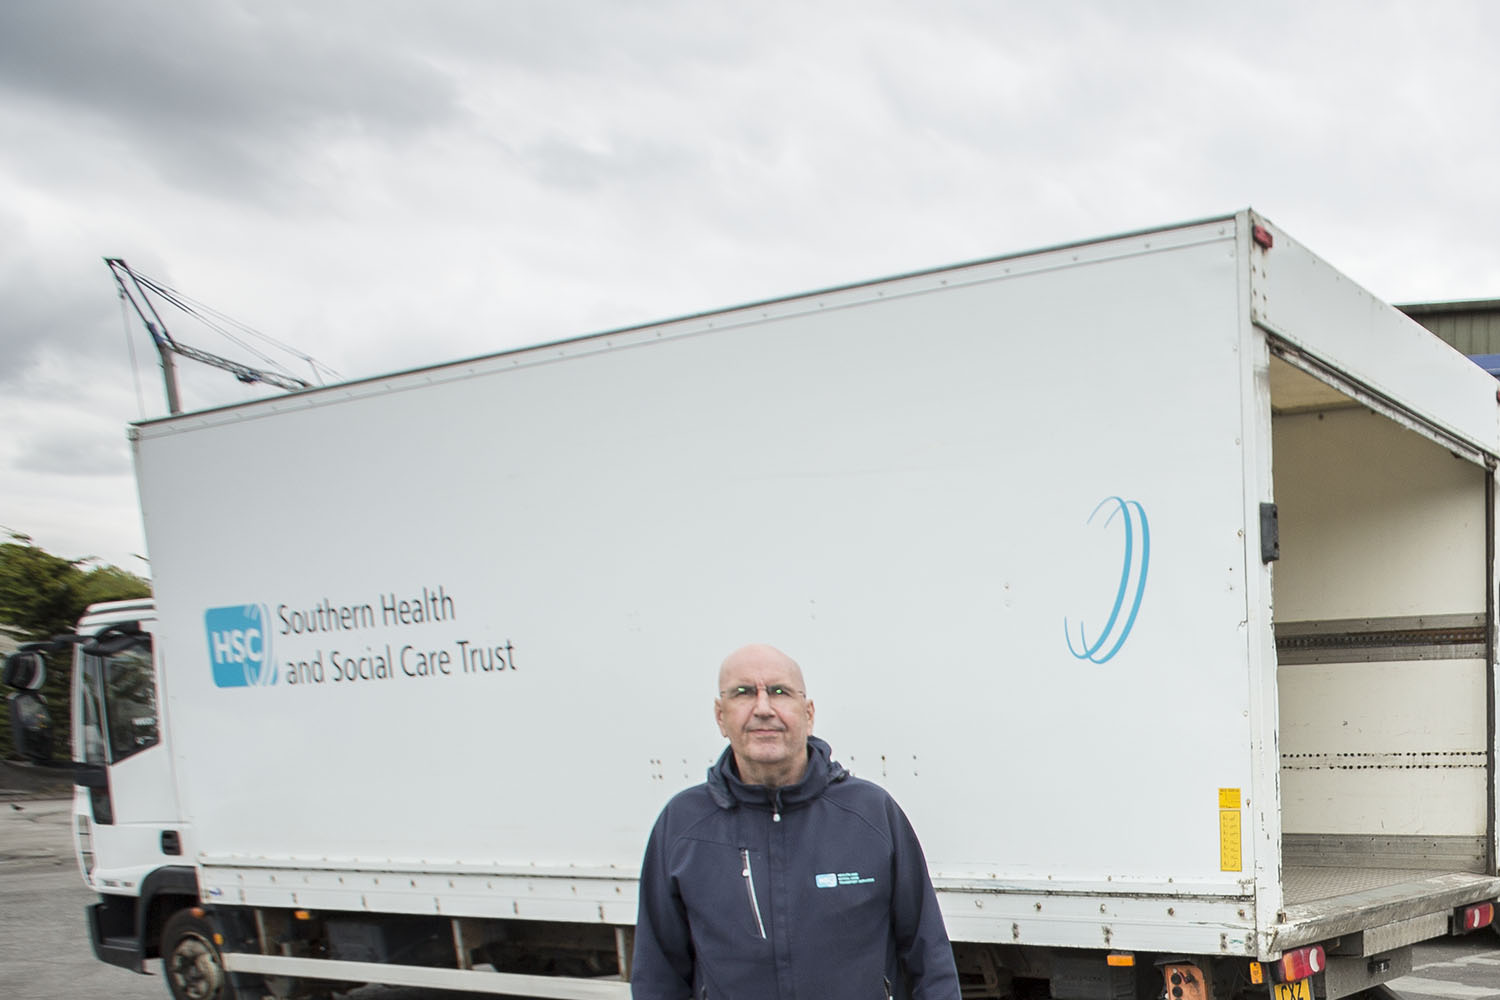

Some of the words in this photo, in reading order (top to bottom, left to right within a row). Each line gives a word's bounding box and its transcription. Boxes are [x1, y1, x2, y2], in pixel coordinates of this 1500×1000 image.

[277, 597, 376, 636] Southern
[379, 584, 457, 626] Health
[211, 628, 263, 664] HSC
[285, 649, 327, 686] and
[331, 644, 394, 683] Social
[399, 644, 452, 679] Care
[456, 638, 518, 673] Trust
